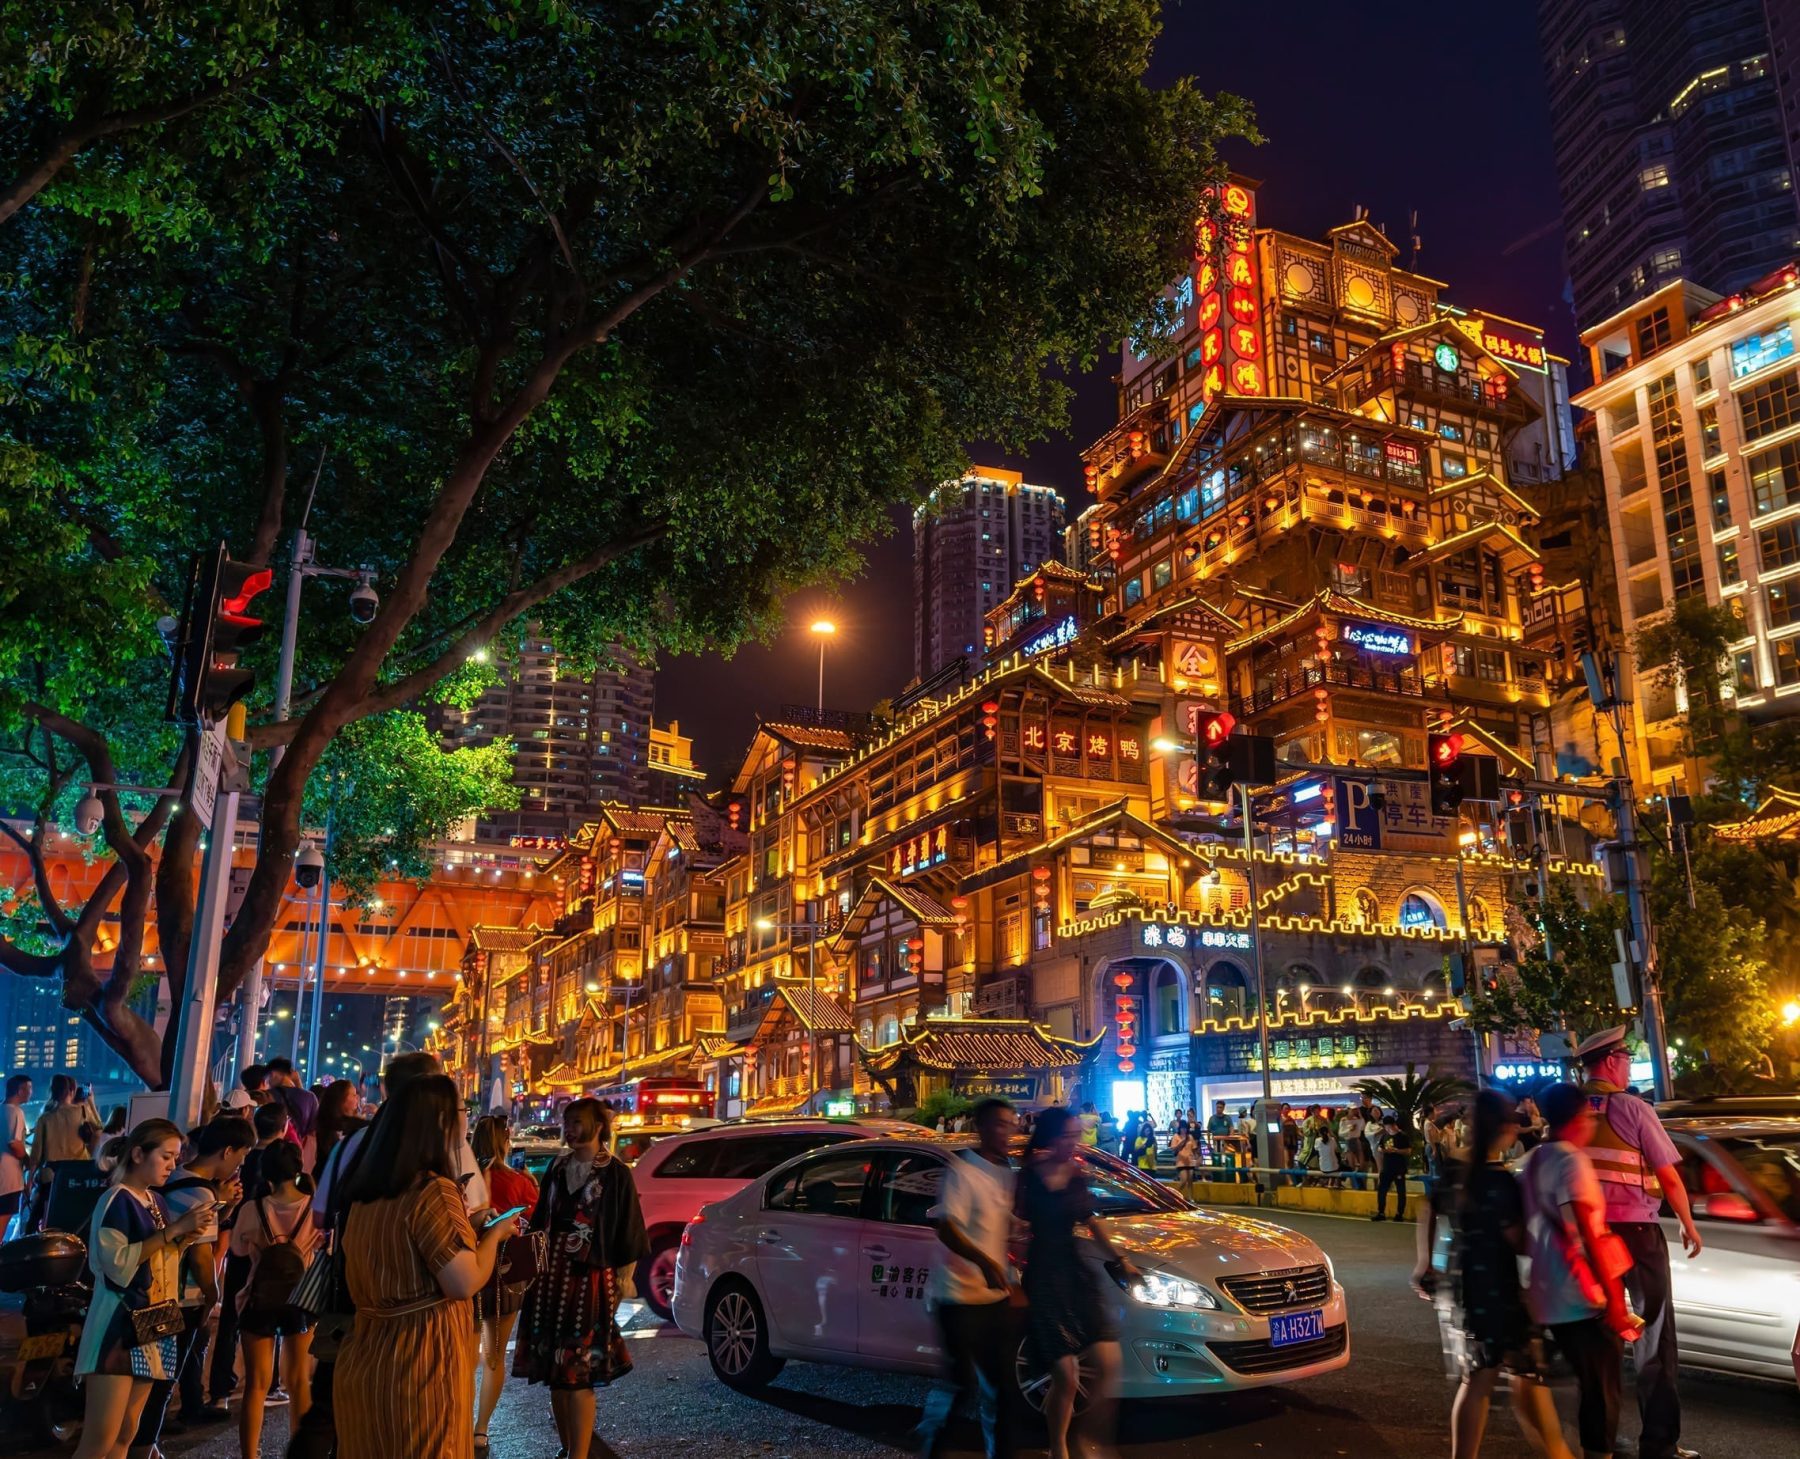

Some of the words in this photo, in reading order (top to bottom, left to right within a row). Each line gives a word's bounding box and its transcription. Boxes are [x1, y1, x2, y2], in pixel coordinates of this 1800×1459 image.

[1343, 242, 1385, 263] SUBWAY
[1485, 334, 1543, 365] 码头火锅
[1024, 726, 1139, 760] 北京烤鸭
[1342, 780, 1371, 831] P
[511, 837, 566, 850] 刘一手火
[1343, 832, 1373, 847] 24小时
